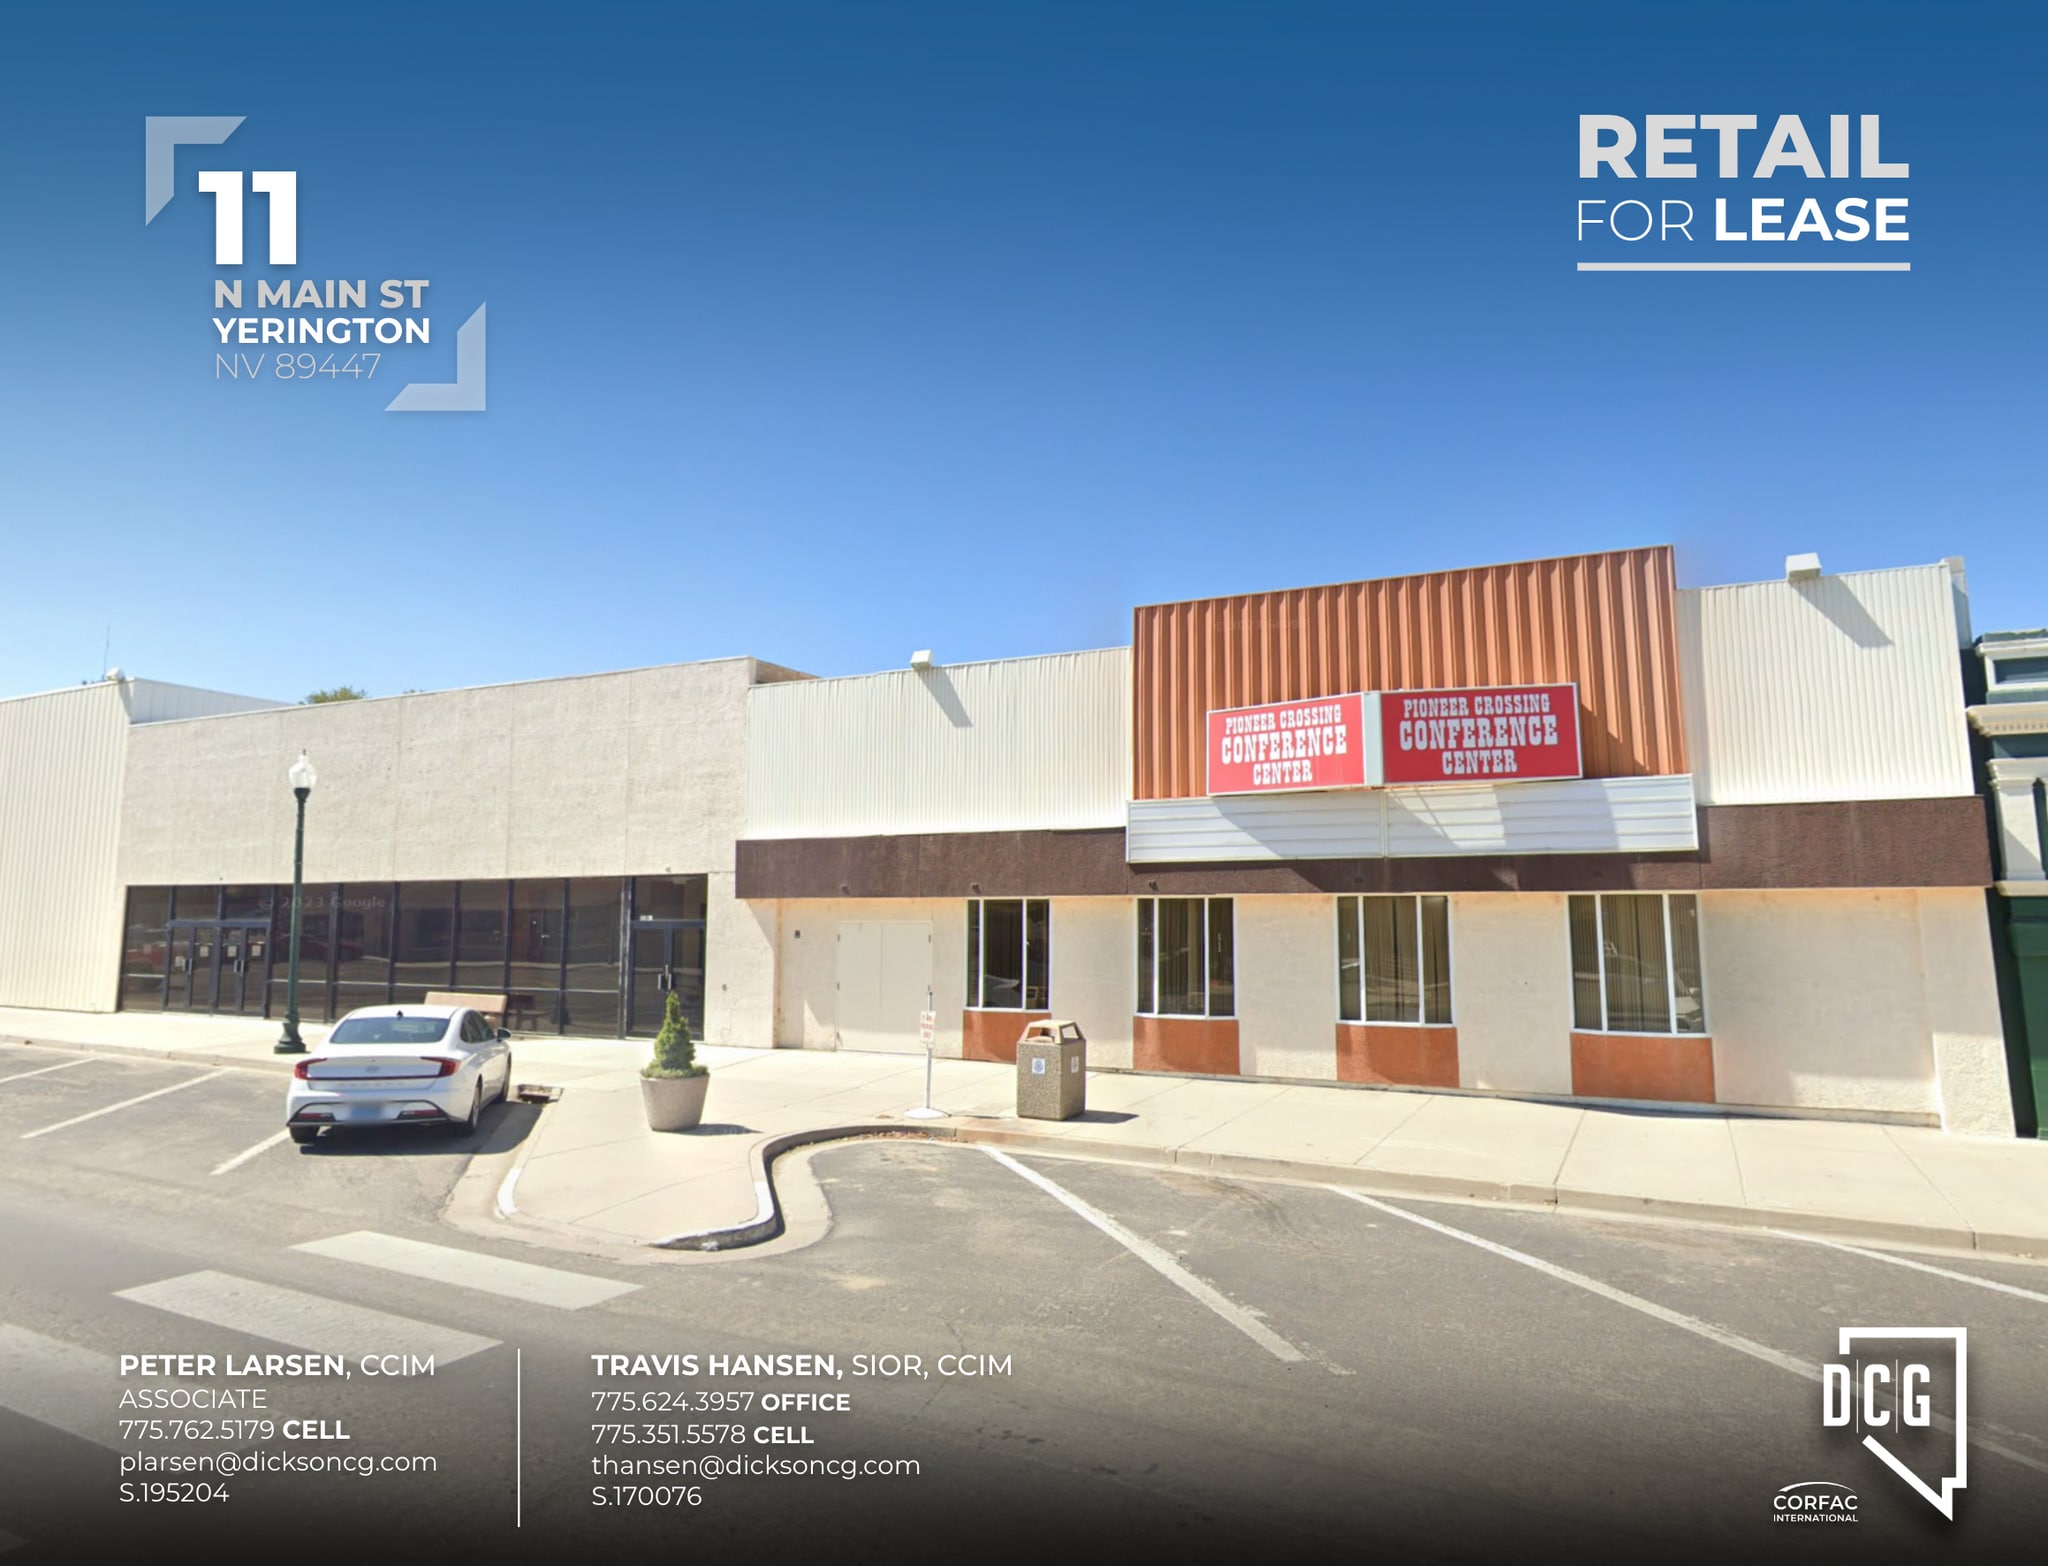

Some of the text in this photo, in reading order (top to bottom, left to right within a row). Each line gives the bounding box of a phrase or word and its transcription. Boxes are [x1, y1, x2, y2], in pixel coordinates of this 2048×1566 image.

[1225, 704, 1341, 735] PIONEER CROSSING
[1404, 693, 1550, 718] PIONEER CROSSING
[1221, 724, 1347, 765] CONFERENCE
[1400, 715, 1558, 750] CONFERENCE
[1253, 759, 1313, 785] CENTER
[1442, 749, 1518, 775] CENTER
